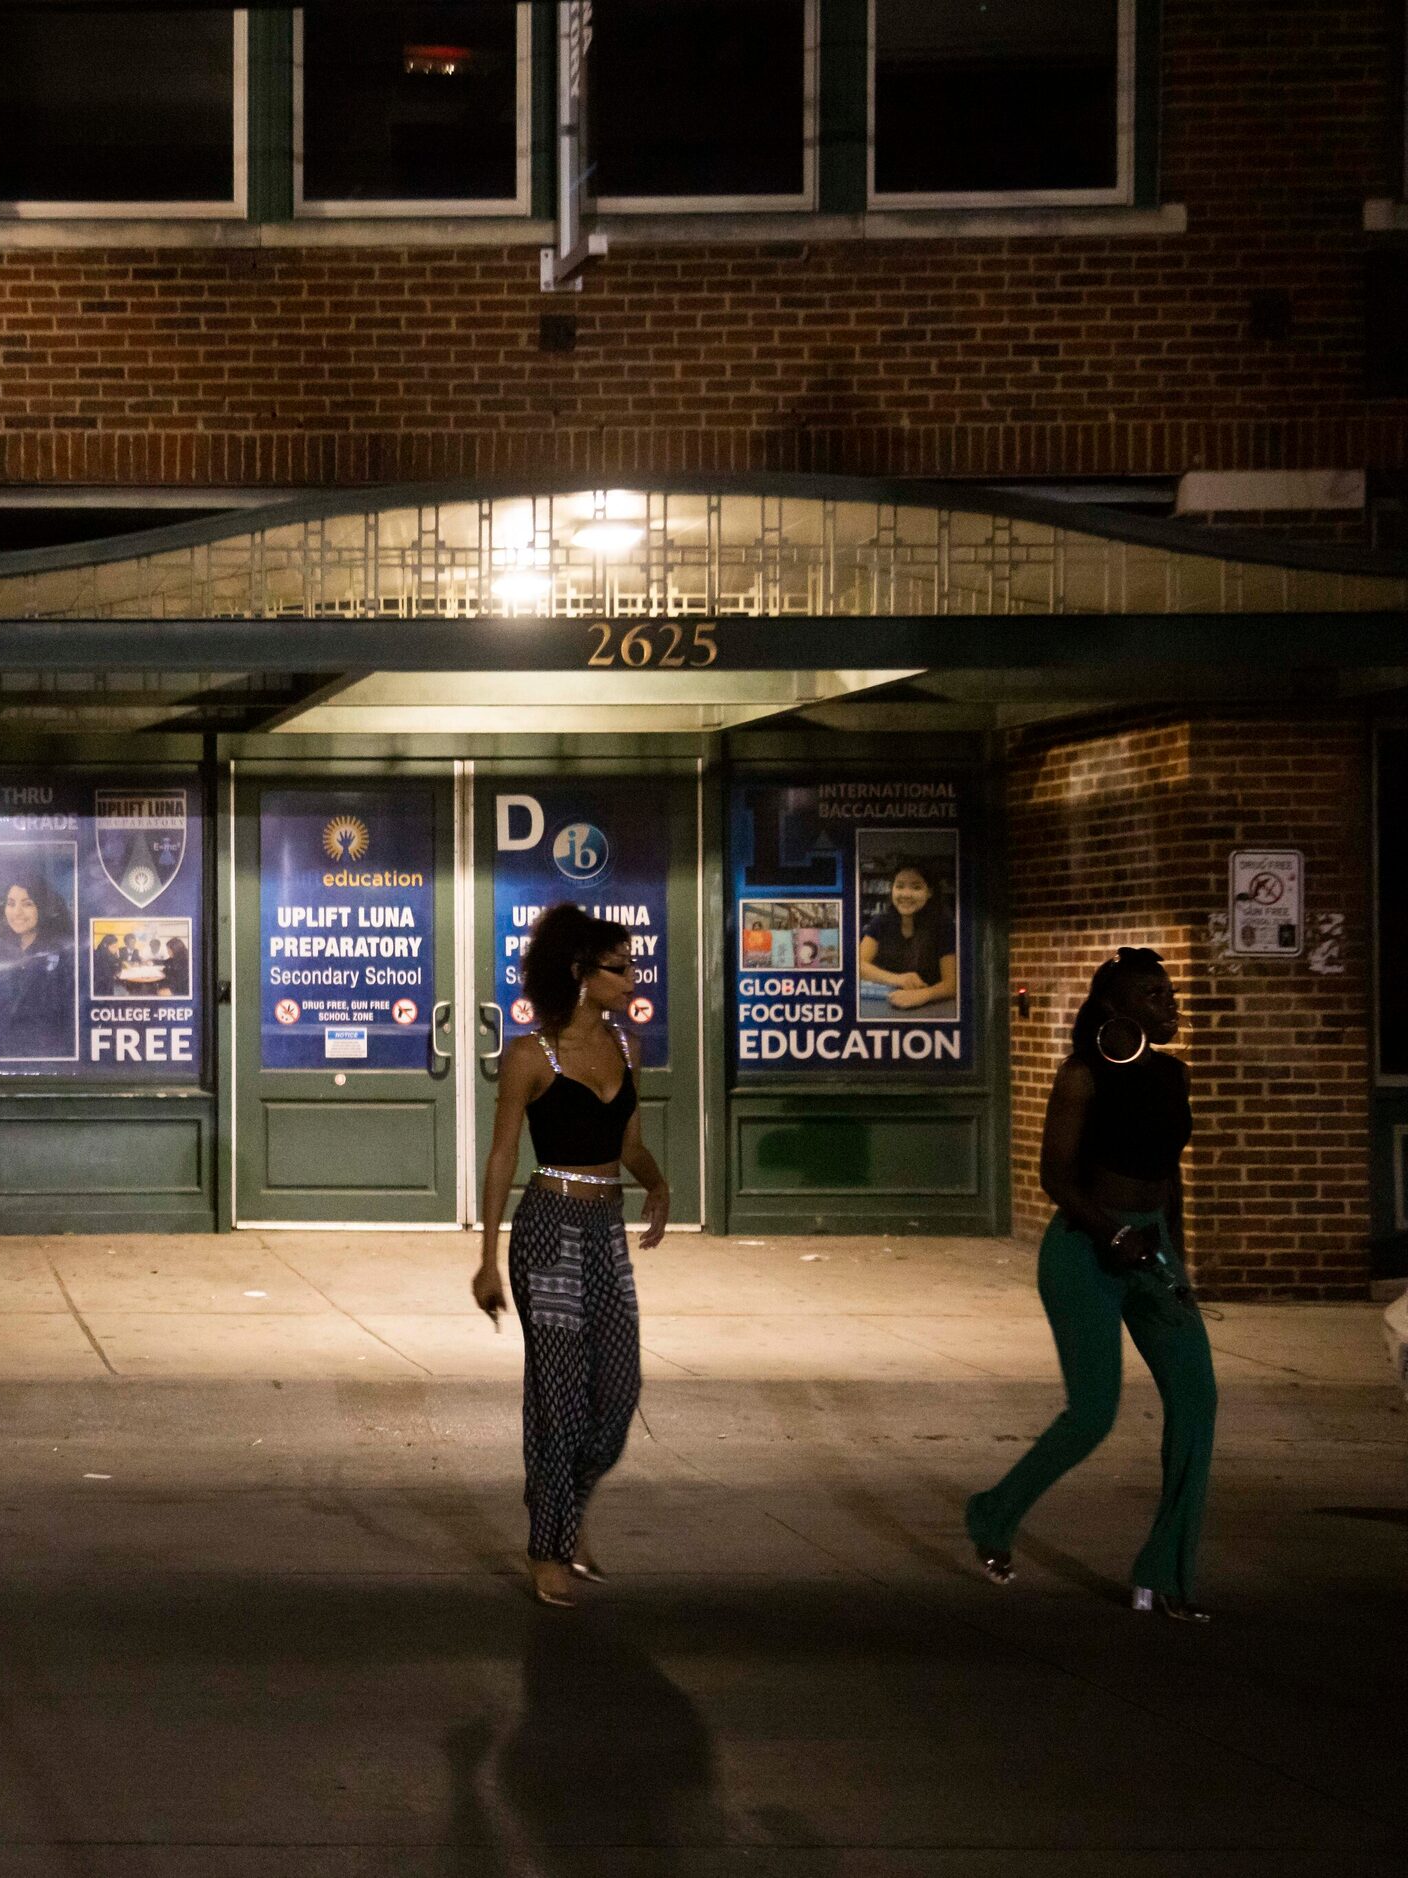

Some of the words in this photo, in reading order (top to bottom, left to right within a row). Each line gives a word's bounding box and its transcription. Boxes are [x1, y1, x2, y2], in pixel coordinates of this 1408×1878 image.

[588, 622, 718, 667] 2625
[2, 786, 53, 805] THRU
[818, 783, 956, 799] INTERNATIONAL
[97, 800, 144, 817] UPLIFT
[148, 800, 185, 817] LUNA
[818, 802, 958, 818] BACCALAUREATE
[496, 794, 545, 851] D
[322, 869, 424, 887] education
[277, 906, 351, 928] UPLIFT
[357, 906, 415, 928] LUNA
[270, 936, 423, 958] PREPARATORY
[270, 967, 359, 989] Secondary
[365, 966, 422, 985] School
[739, 978, 844, 996] GLOBALLY
[90, 1008, 151, 1022] COLLEGE
[302, 1000, 325, 1010] DRUG
[326, 1000, 350, 1011] FREE,
[351, 1000, 368, 1010] GUN
[370, 1000, 390, 1010] FREE
[739, 1004, 843, 1023] FOCUSED
[318, 1012, 350, 1021] SCHOOL
[352, 1012, 374, 1021] ZONE
[91, 1027, 193, 1061] FREE
[739, 1029, 961, 1060] EDUCATION
